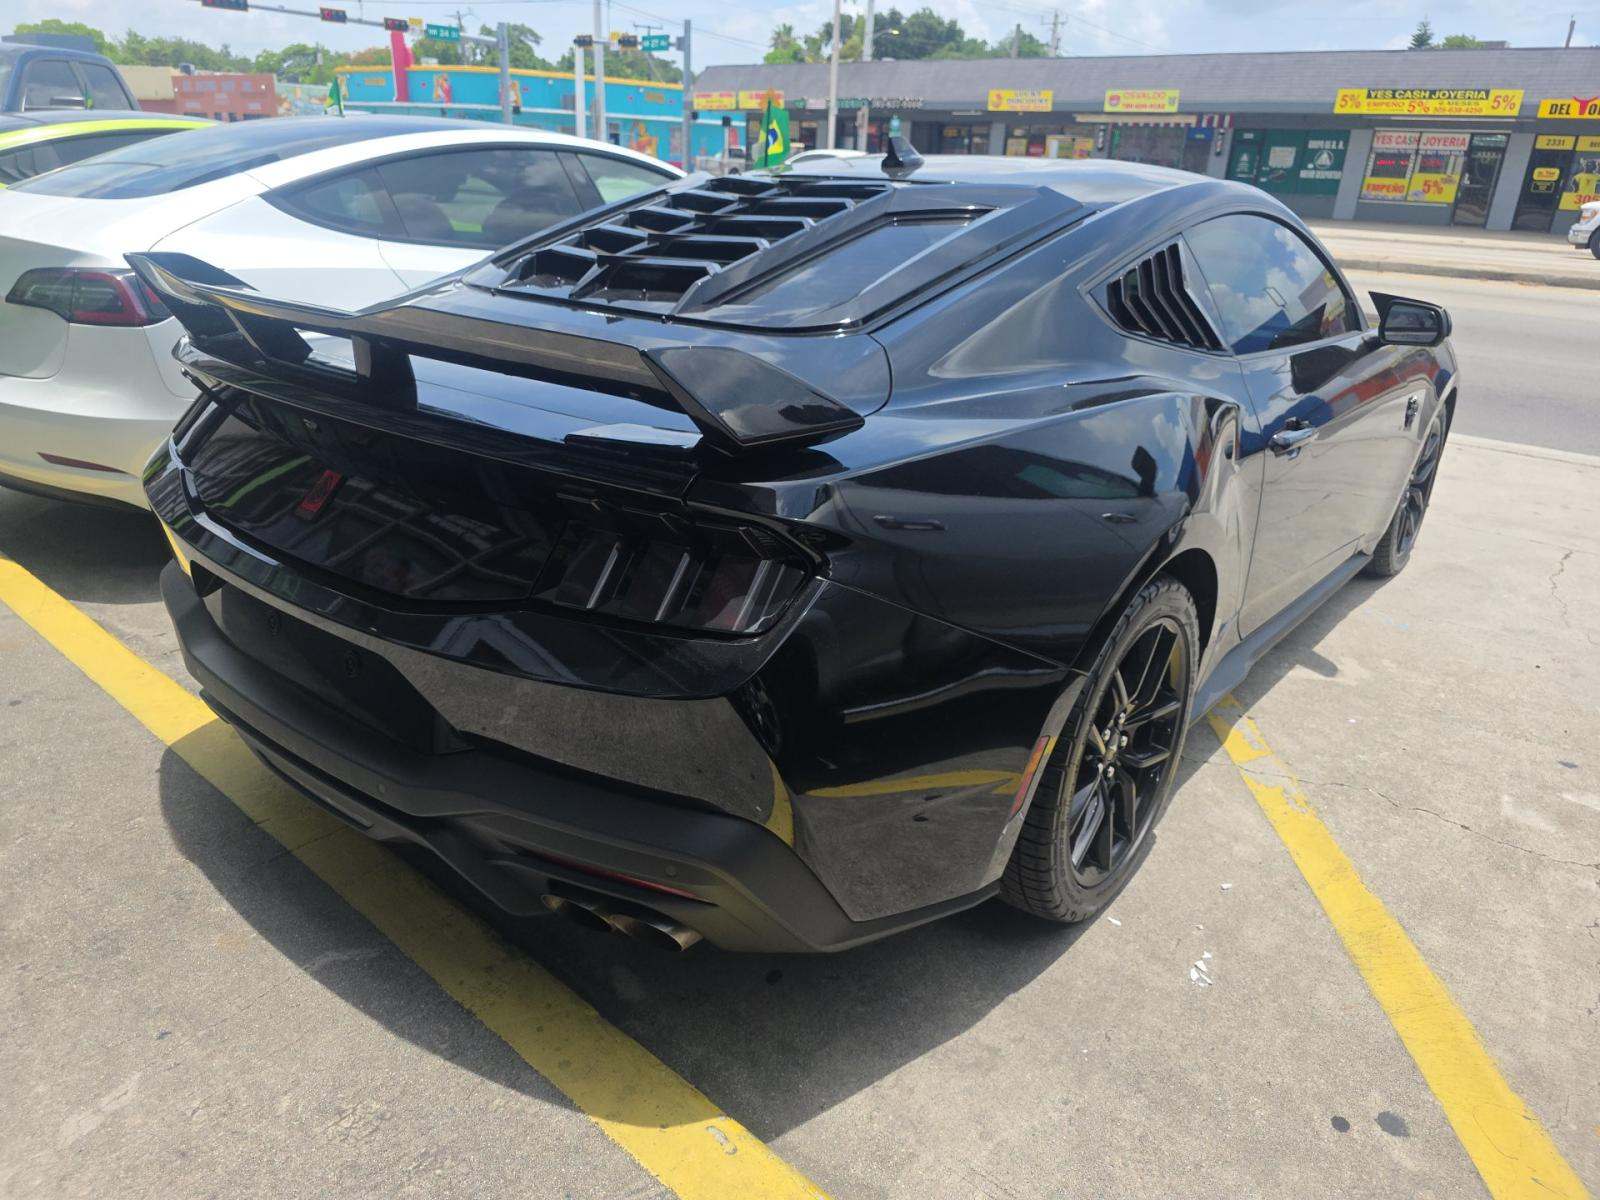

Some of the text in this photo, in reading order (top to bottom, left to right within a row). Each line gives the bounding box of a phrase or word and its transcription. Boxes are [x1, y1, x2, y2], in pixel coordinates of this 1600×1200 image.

[1369, 89, 1487, 99] YES CASH JOYERIA
[1339, 94, 1361, 109] 5%
[1407, 101, 1430, 113] 5%
[1491, 93, 1516, 110] 5%
[1548, 103, 1571, 115] DEL
[1375, 134, 1393, 145] YES
[1394, 135, 1420, 146] CASH
[1422, 136, 1467, 147] JOYERIA
[1422, 180, 1444, 195] 5%
